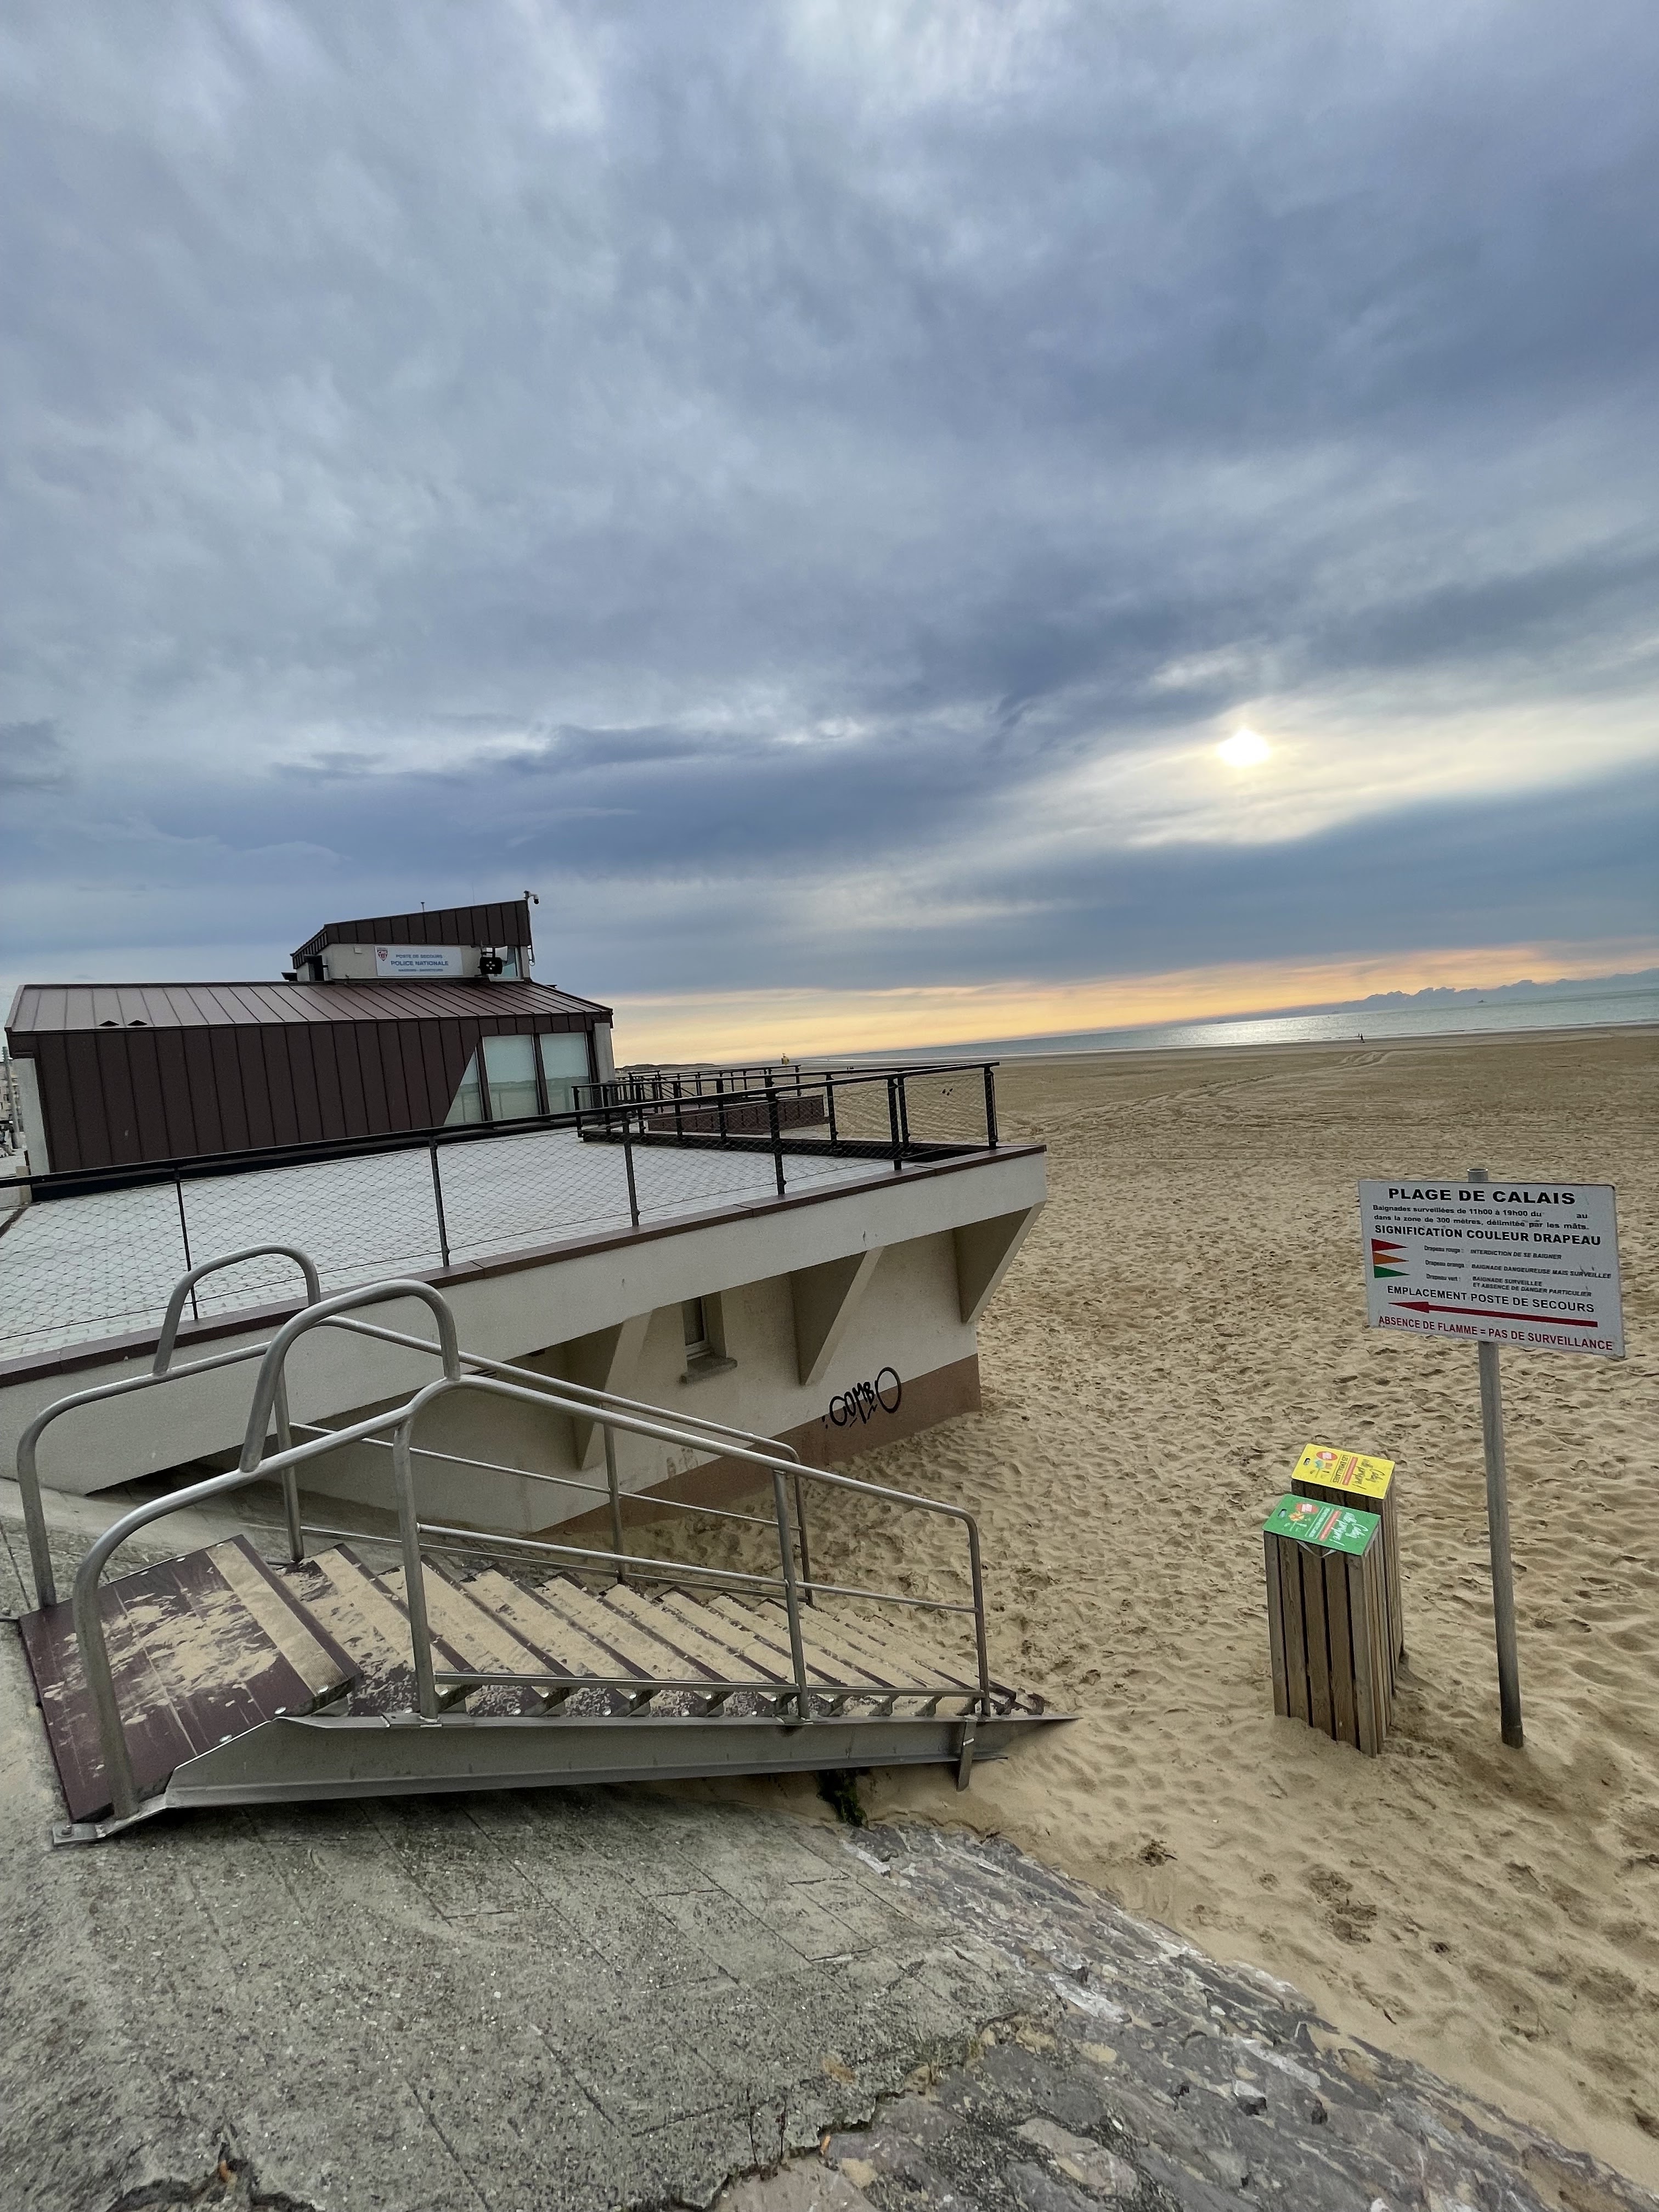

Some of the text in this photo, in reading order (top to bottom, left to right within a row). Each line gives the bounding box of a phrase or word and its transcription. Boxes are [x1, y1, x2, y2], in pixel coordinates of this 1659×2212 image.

[1389, 1188, 1575, 1205] PLAGE DE CALAIS
[1375, 1224, 1601, 1245] SIGNIFICATION COULEUR DRAPEAU
[1387, 1286, 1594, 1312] EMPLACEMENT POSTE DE SECOURS
[1549, 1289, 1592, 1297] PARTICULIER
[1379, 1316, 1420, 1328] ABSENCE
[1423, 1321, 1435, 1330] DE
[1438, 1323, 1477, 1335] FLAMME
[1488, 1329, 1508, 1338] PAS
[1511, 1331, 1525, 1340] DE
[1528, 1333, 1612, 1351] SURVEILLANCE
